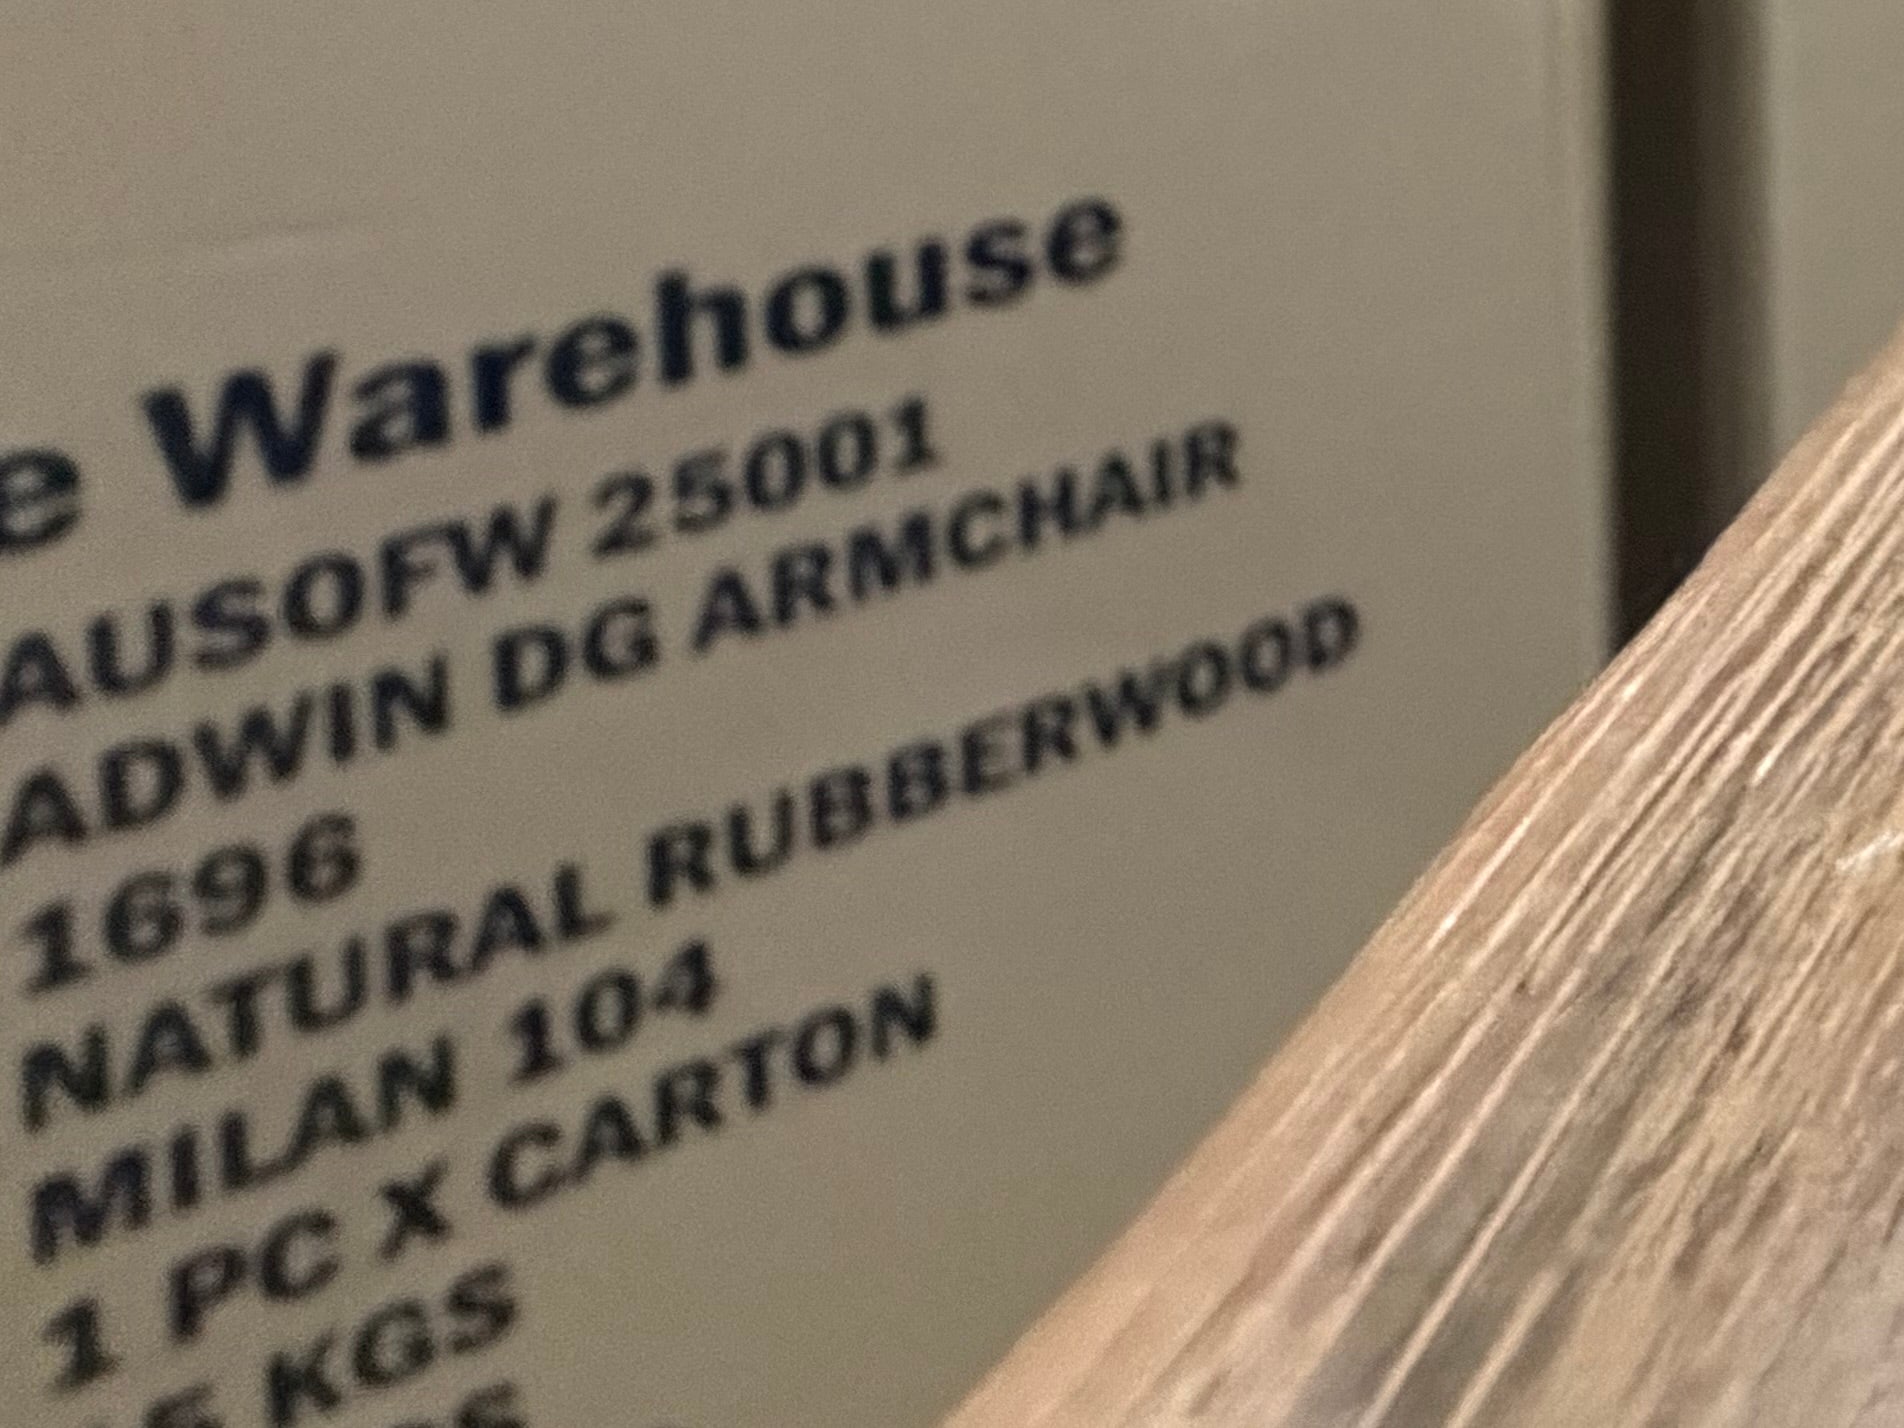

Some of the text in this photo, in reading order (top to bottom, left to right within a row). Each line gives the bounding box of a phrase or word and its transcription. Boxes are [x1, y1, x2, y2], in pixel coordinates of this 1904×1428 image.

[143, 194, 1128, 516] Warehouse
[0, 394, 944, 728] AUSOFW 25001
[0, 417, 1244, 874] ADWIN DG ARMCHAIR
[20, 594, 1364, 1136] NATURAL RUBBERWOOD
[20, 809, 364, 998] 1696
[28, 938, 726, 1268] MILAN 104
[42, 970, 943, 1396] 1 PC X CARTON
[262, 1261, 520, 1428] KGS
